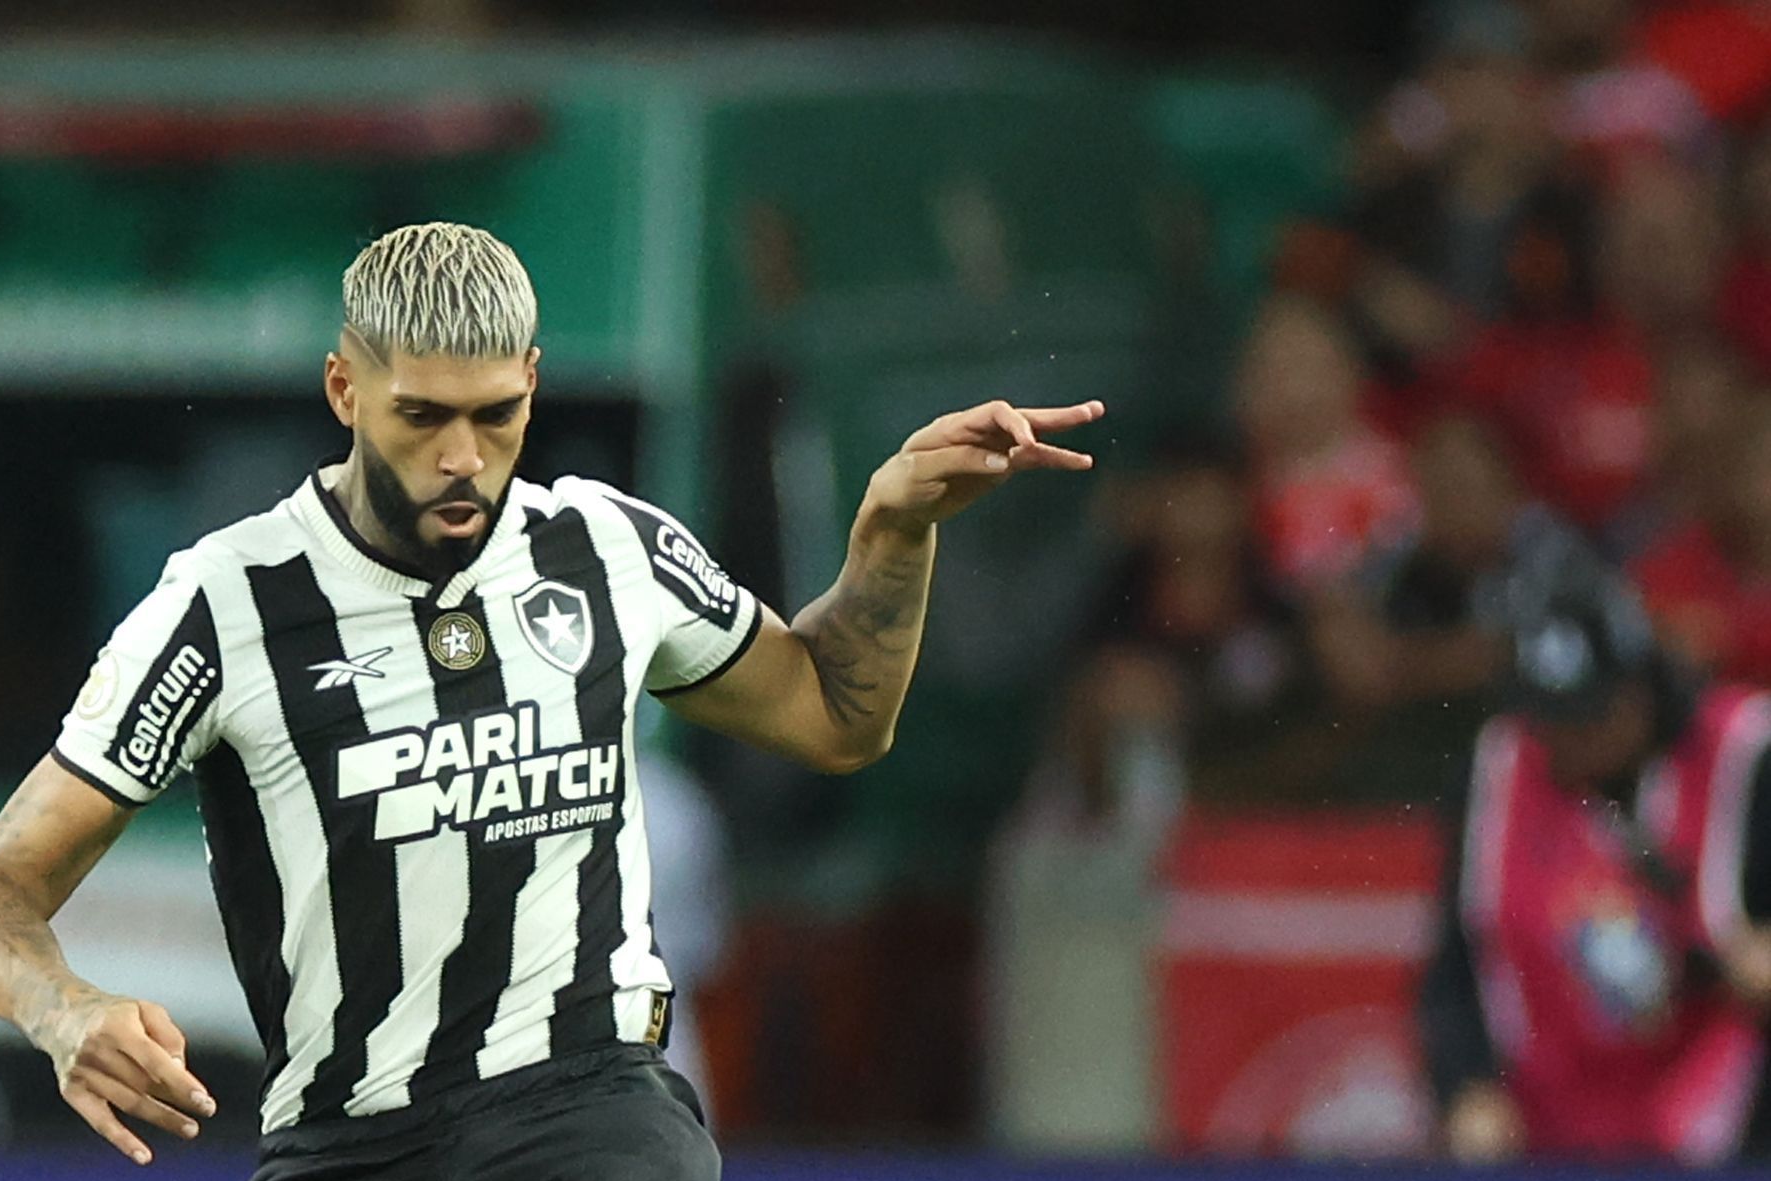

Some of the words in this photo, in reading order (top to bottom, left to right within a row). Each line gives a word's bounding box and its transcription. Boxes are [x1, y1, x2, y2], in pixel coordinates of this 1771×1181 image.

[119, 645, 206, 776] Centrum
[338, 706, 534, 799] PARI
[374, 744, 618, 840] MATCH
[484, 813, 549, 842] APOSTAS
